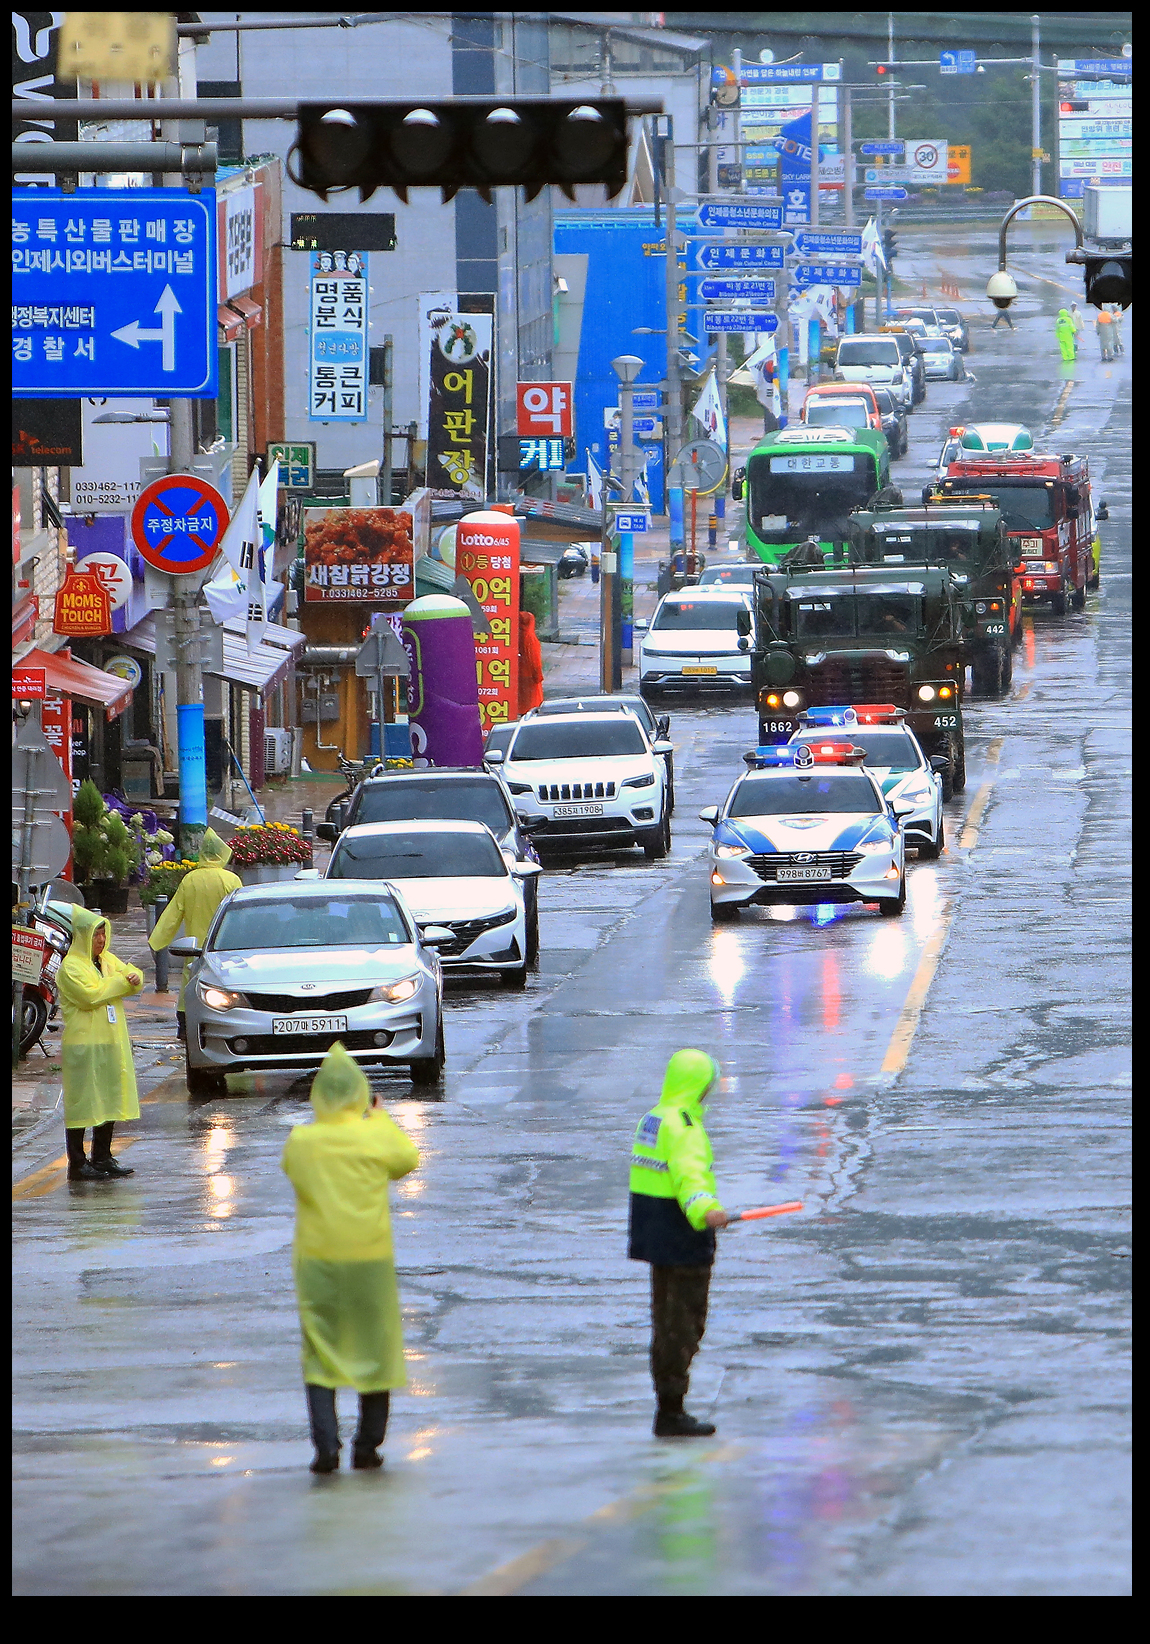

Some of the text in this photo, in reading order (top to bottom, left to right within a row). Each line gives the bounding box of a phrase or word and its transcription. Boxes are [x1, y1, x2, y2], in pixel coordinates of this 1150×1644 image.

[775, 137, 812, 159] HOTE
[919, 151, 934, 162] 30
[12, 248, 194, 273] 인제시외버스터미널
[315, 282, 363, 304] 명품
[315, 306, 363, 328] 분식
[12, 336, 95, 361] 경찰서
[314, 366, 362, 389] 통큰
[314, 391, 362, 413] 커피
[523, 387, 566, 433] 약
[31, 445, 72, 455] telecom
[272, 446, 309, 466] 인제
[787, 457, 841, 469] 대한교통
[75, 481, 141, 492] 033)462-117
[147, 515, 213, 533] 주정차금지
[461, 533, 510, 547] Lotto 6/45
[490, 555, 512, 569] 당첨
[466, 577, 511, 606] 0억
[61, 608, 102, 623] TOUCH
[985, 624, 1004, 634] 442
[763, 721, 792, 733] 1862
[934, 716, 957, 728] 452
[579, 805, 600, 814] 1908
[805, 868, 828, 878] 8767
[278, 1019, 341, 1033] 207마 5911
